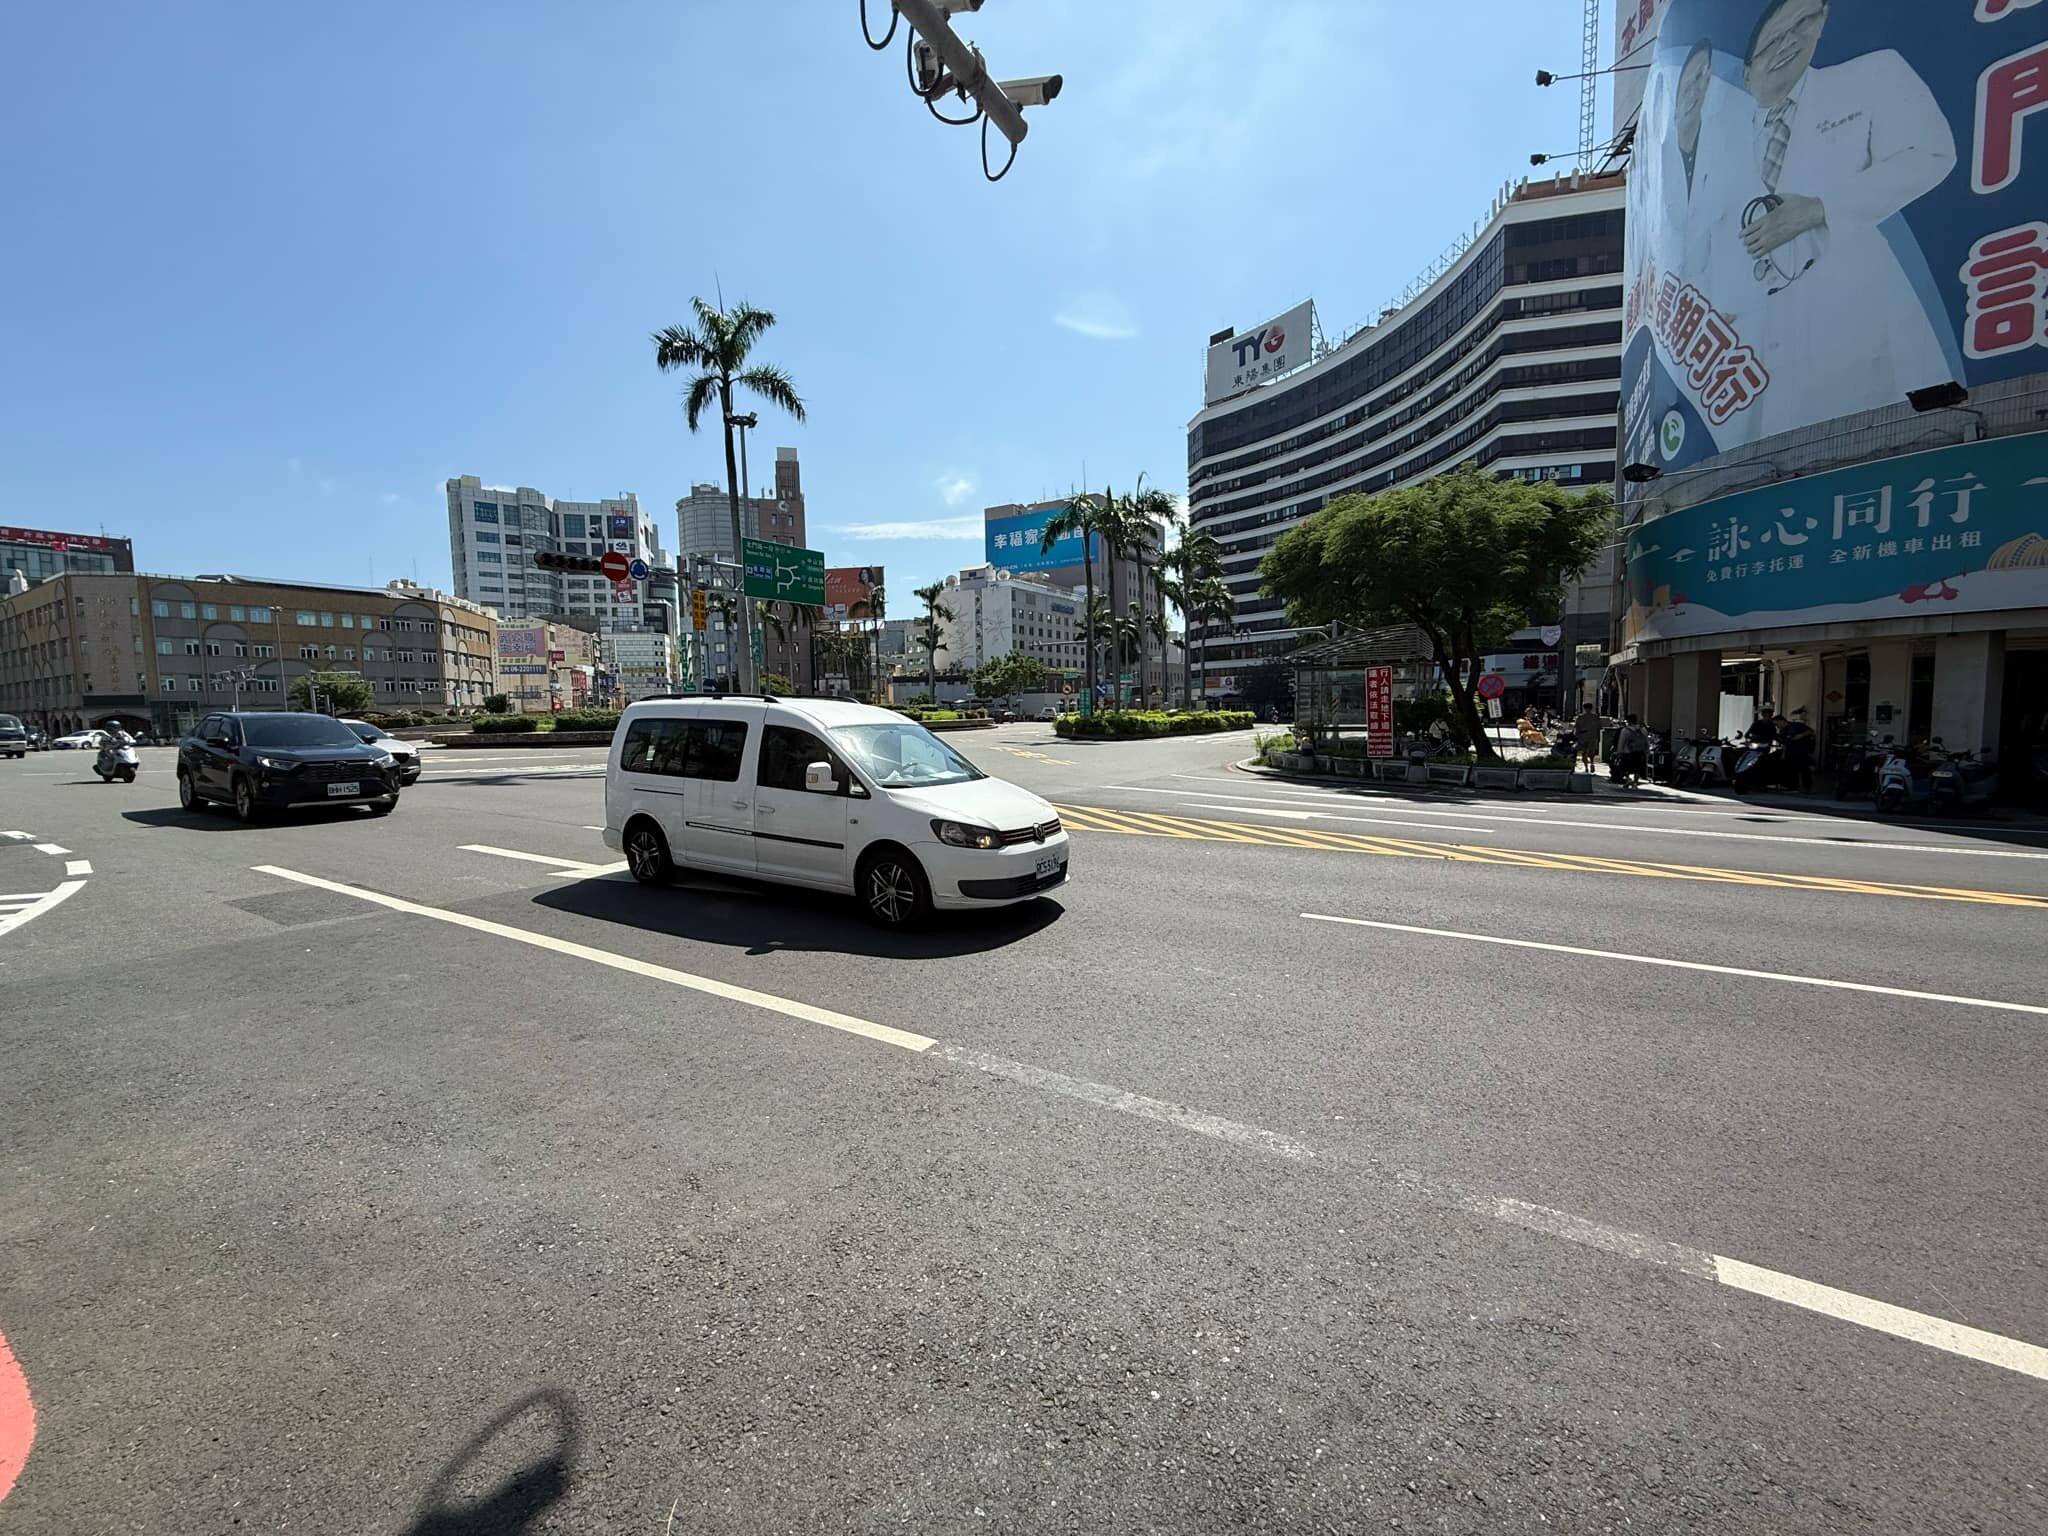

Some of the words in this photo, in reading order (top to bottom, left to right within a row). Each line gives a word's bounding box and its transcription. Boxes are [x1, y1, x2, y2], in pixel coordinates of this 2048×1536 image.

[1707, 472, 1988, 562] 詠心同行
[1705, 553, 1805, 583] 免費行李托運
[1828, 530, 1982, 564] 全新機車出租
